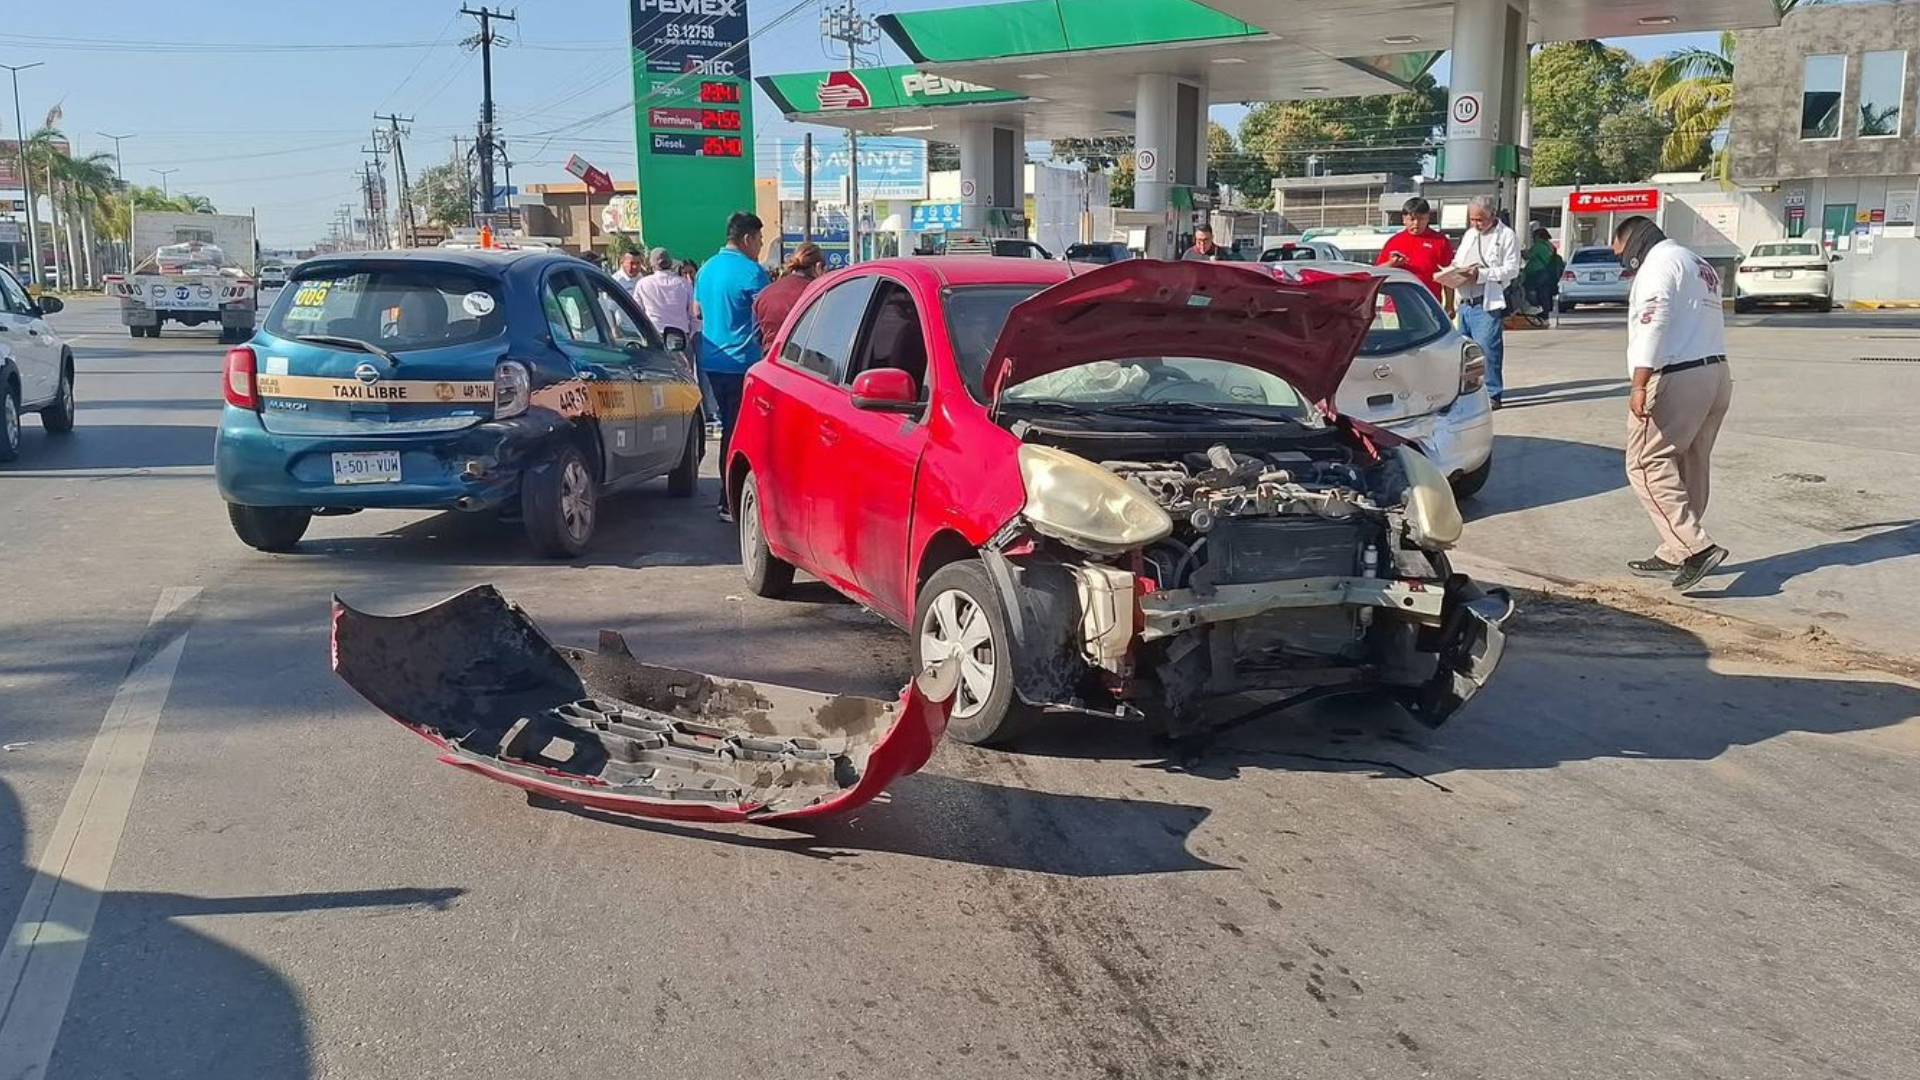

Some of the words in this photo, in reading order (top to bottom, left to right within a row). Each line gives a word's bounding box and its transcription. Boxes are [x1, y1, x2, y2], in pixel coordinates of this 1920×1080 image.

[901, 72, 997, 97] PEM
[1459, 102, 1473, 114] 10
[1593, 194, 1649, 205] BANORTE
[333, 386, 362, 398] TAXI
[366, 387, 407, 399] LIBRE
[270, 401, 308, 411] MARCH
